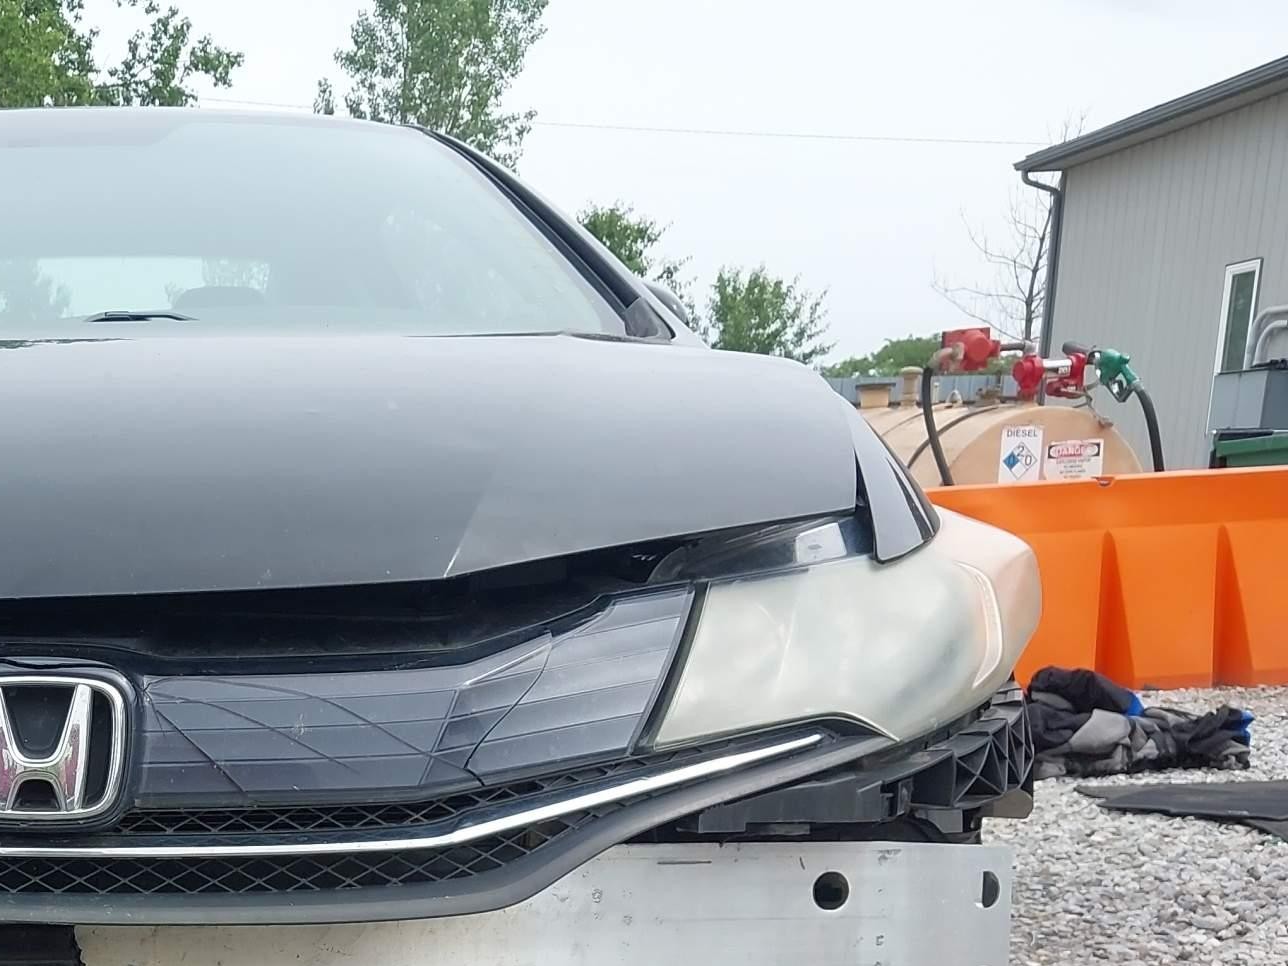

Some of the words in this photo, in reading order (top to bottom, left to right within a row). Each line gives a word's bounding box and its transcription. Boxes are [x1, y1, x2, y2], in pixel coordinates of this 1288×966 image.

[1006, 429, 1038, 438] DIESEL
[1016, 444, 1025, 458] 2
[1055, 445, 1088, 457] DANGE
[1024, 454, 1033, 467] 0
